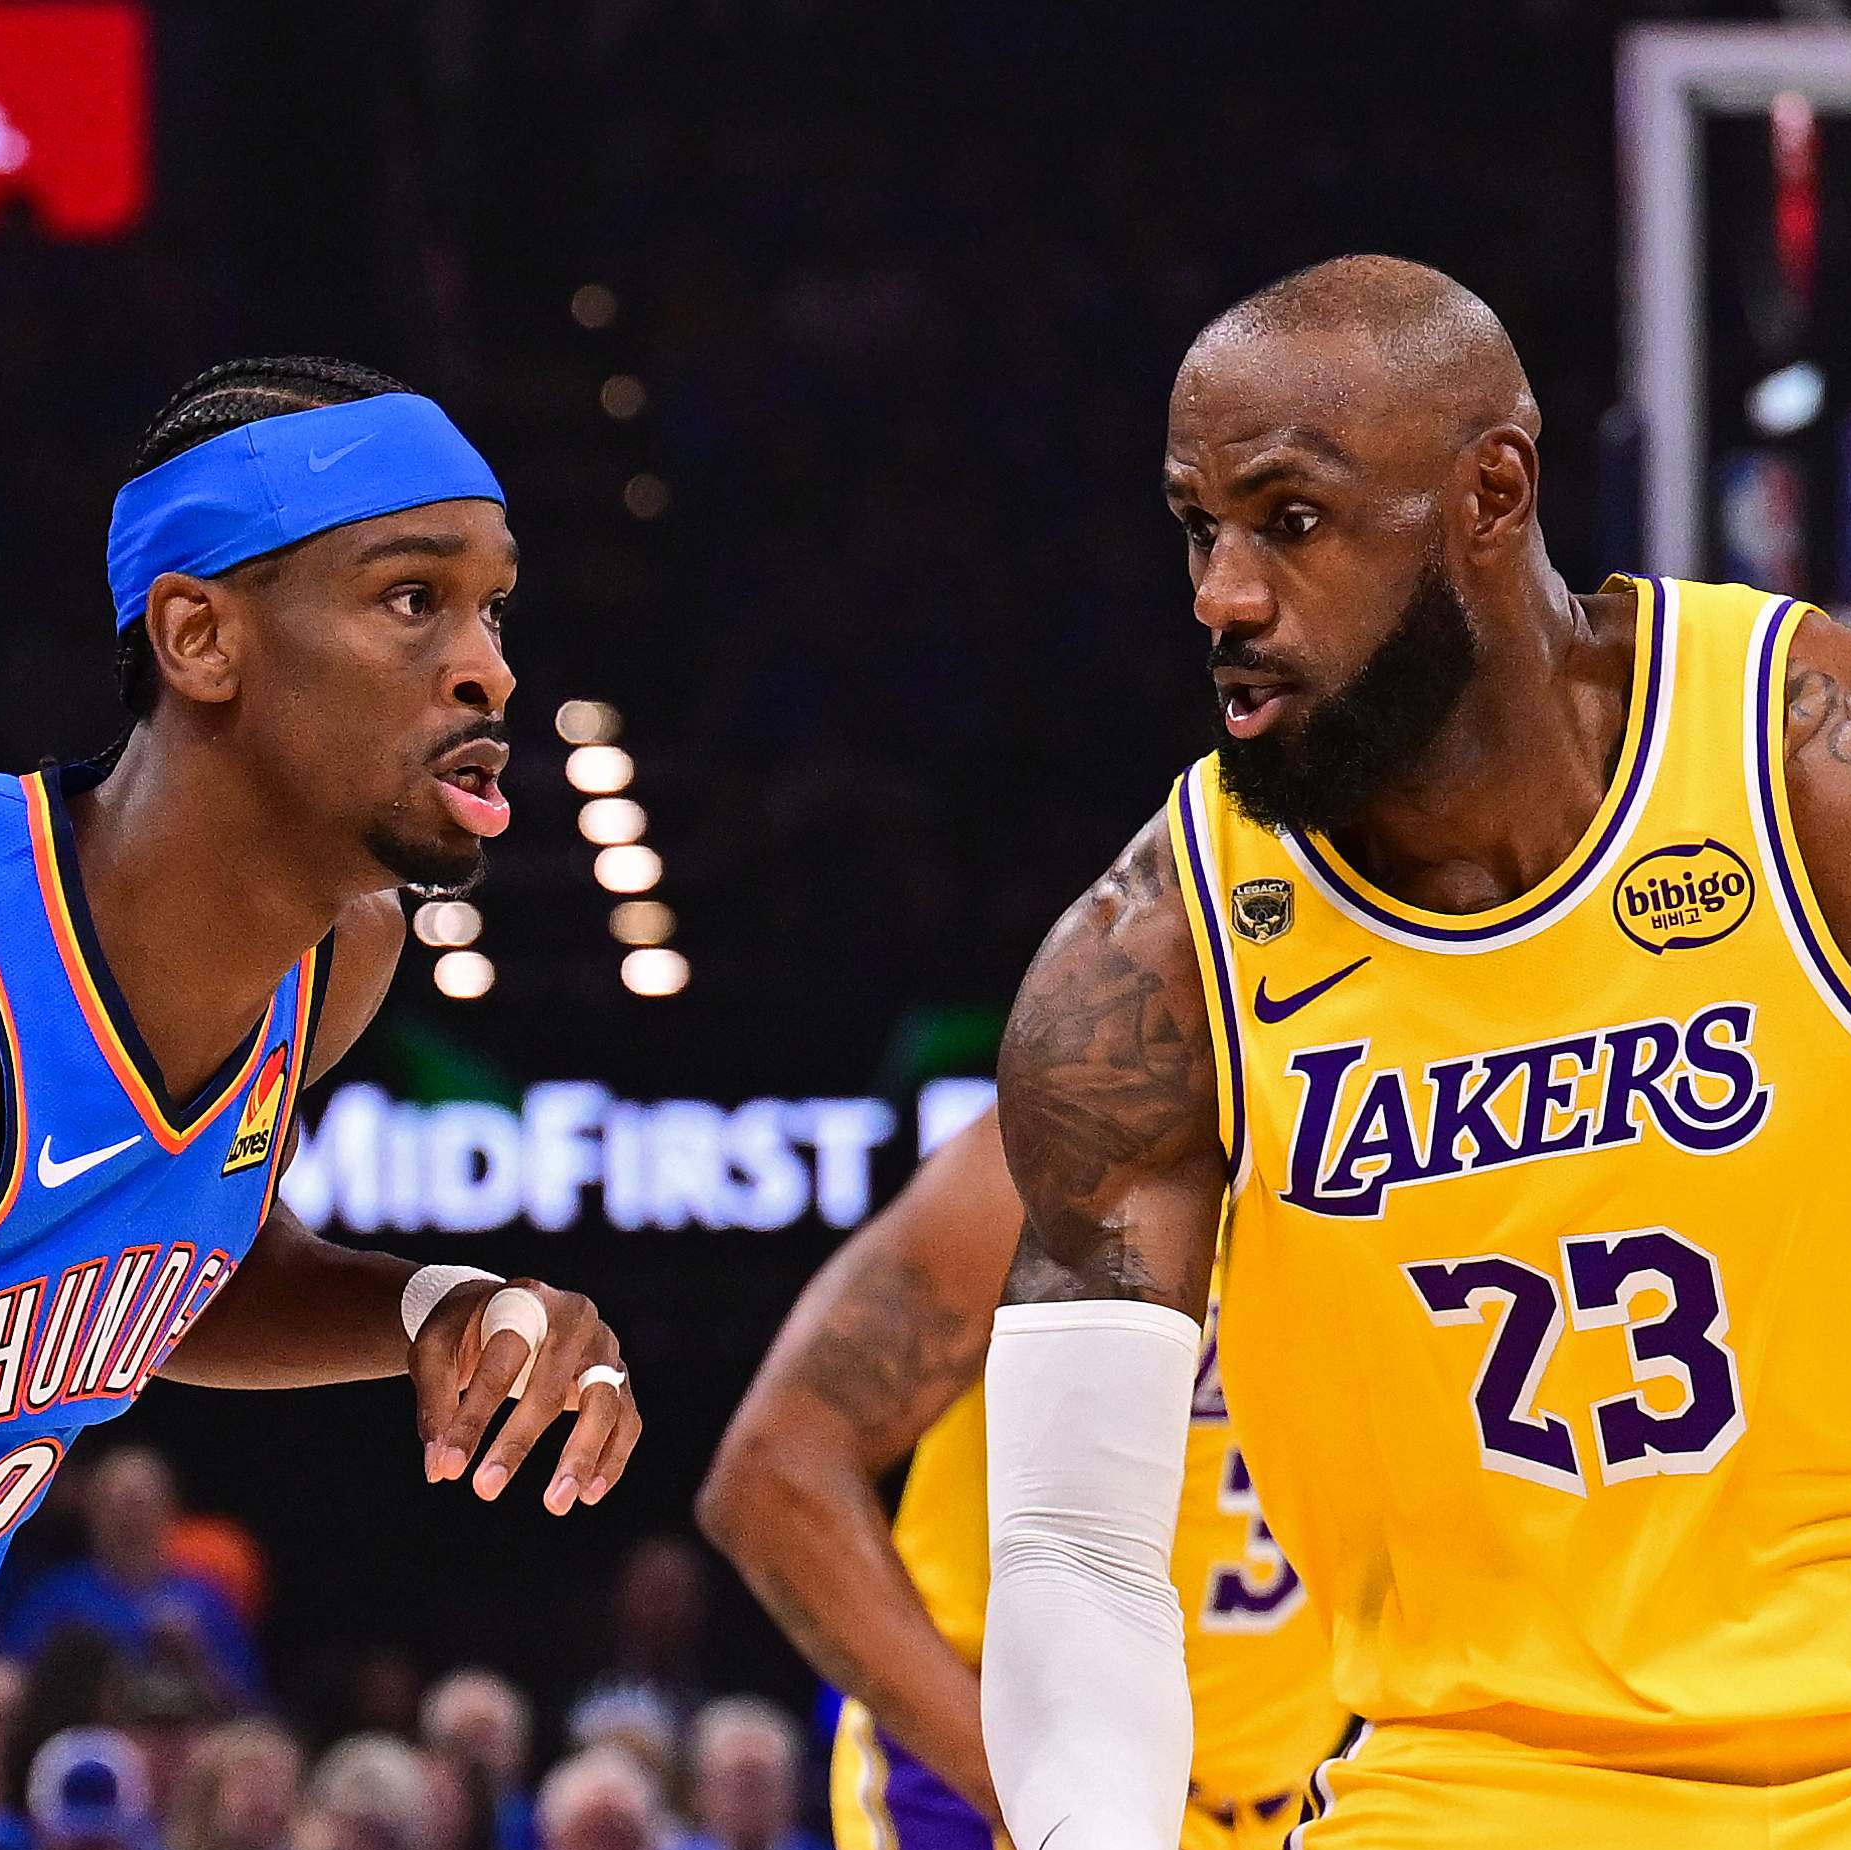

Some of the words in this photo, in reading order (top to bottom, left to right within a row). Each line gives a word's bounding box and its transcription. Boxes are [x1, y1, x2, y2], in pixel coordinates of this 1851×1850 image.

[1236, 882, 1286, 896] LEGACY
[1624, 870, 1745, 917] bibigo
[1651, 907, 1702, 930] 비비고
[1278, 1001, 1775, 1220] LAKERS
[1398, 1224, 1747, 1498] 23
